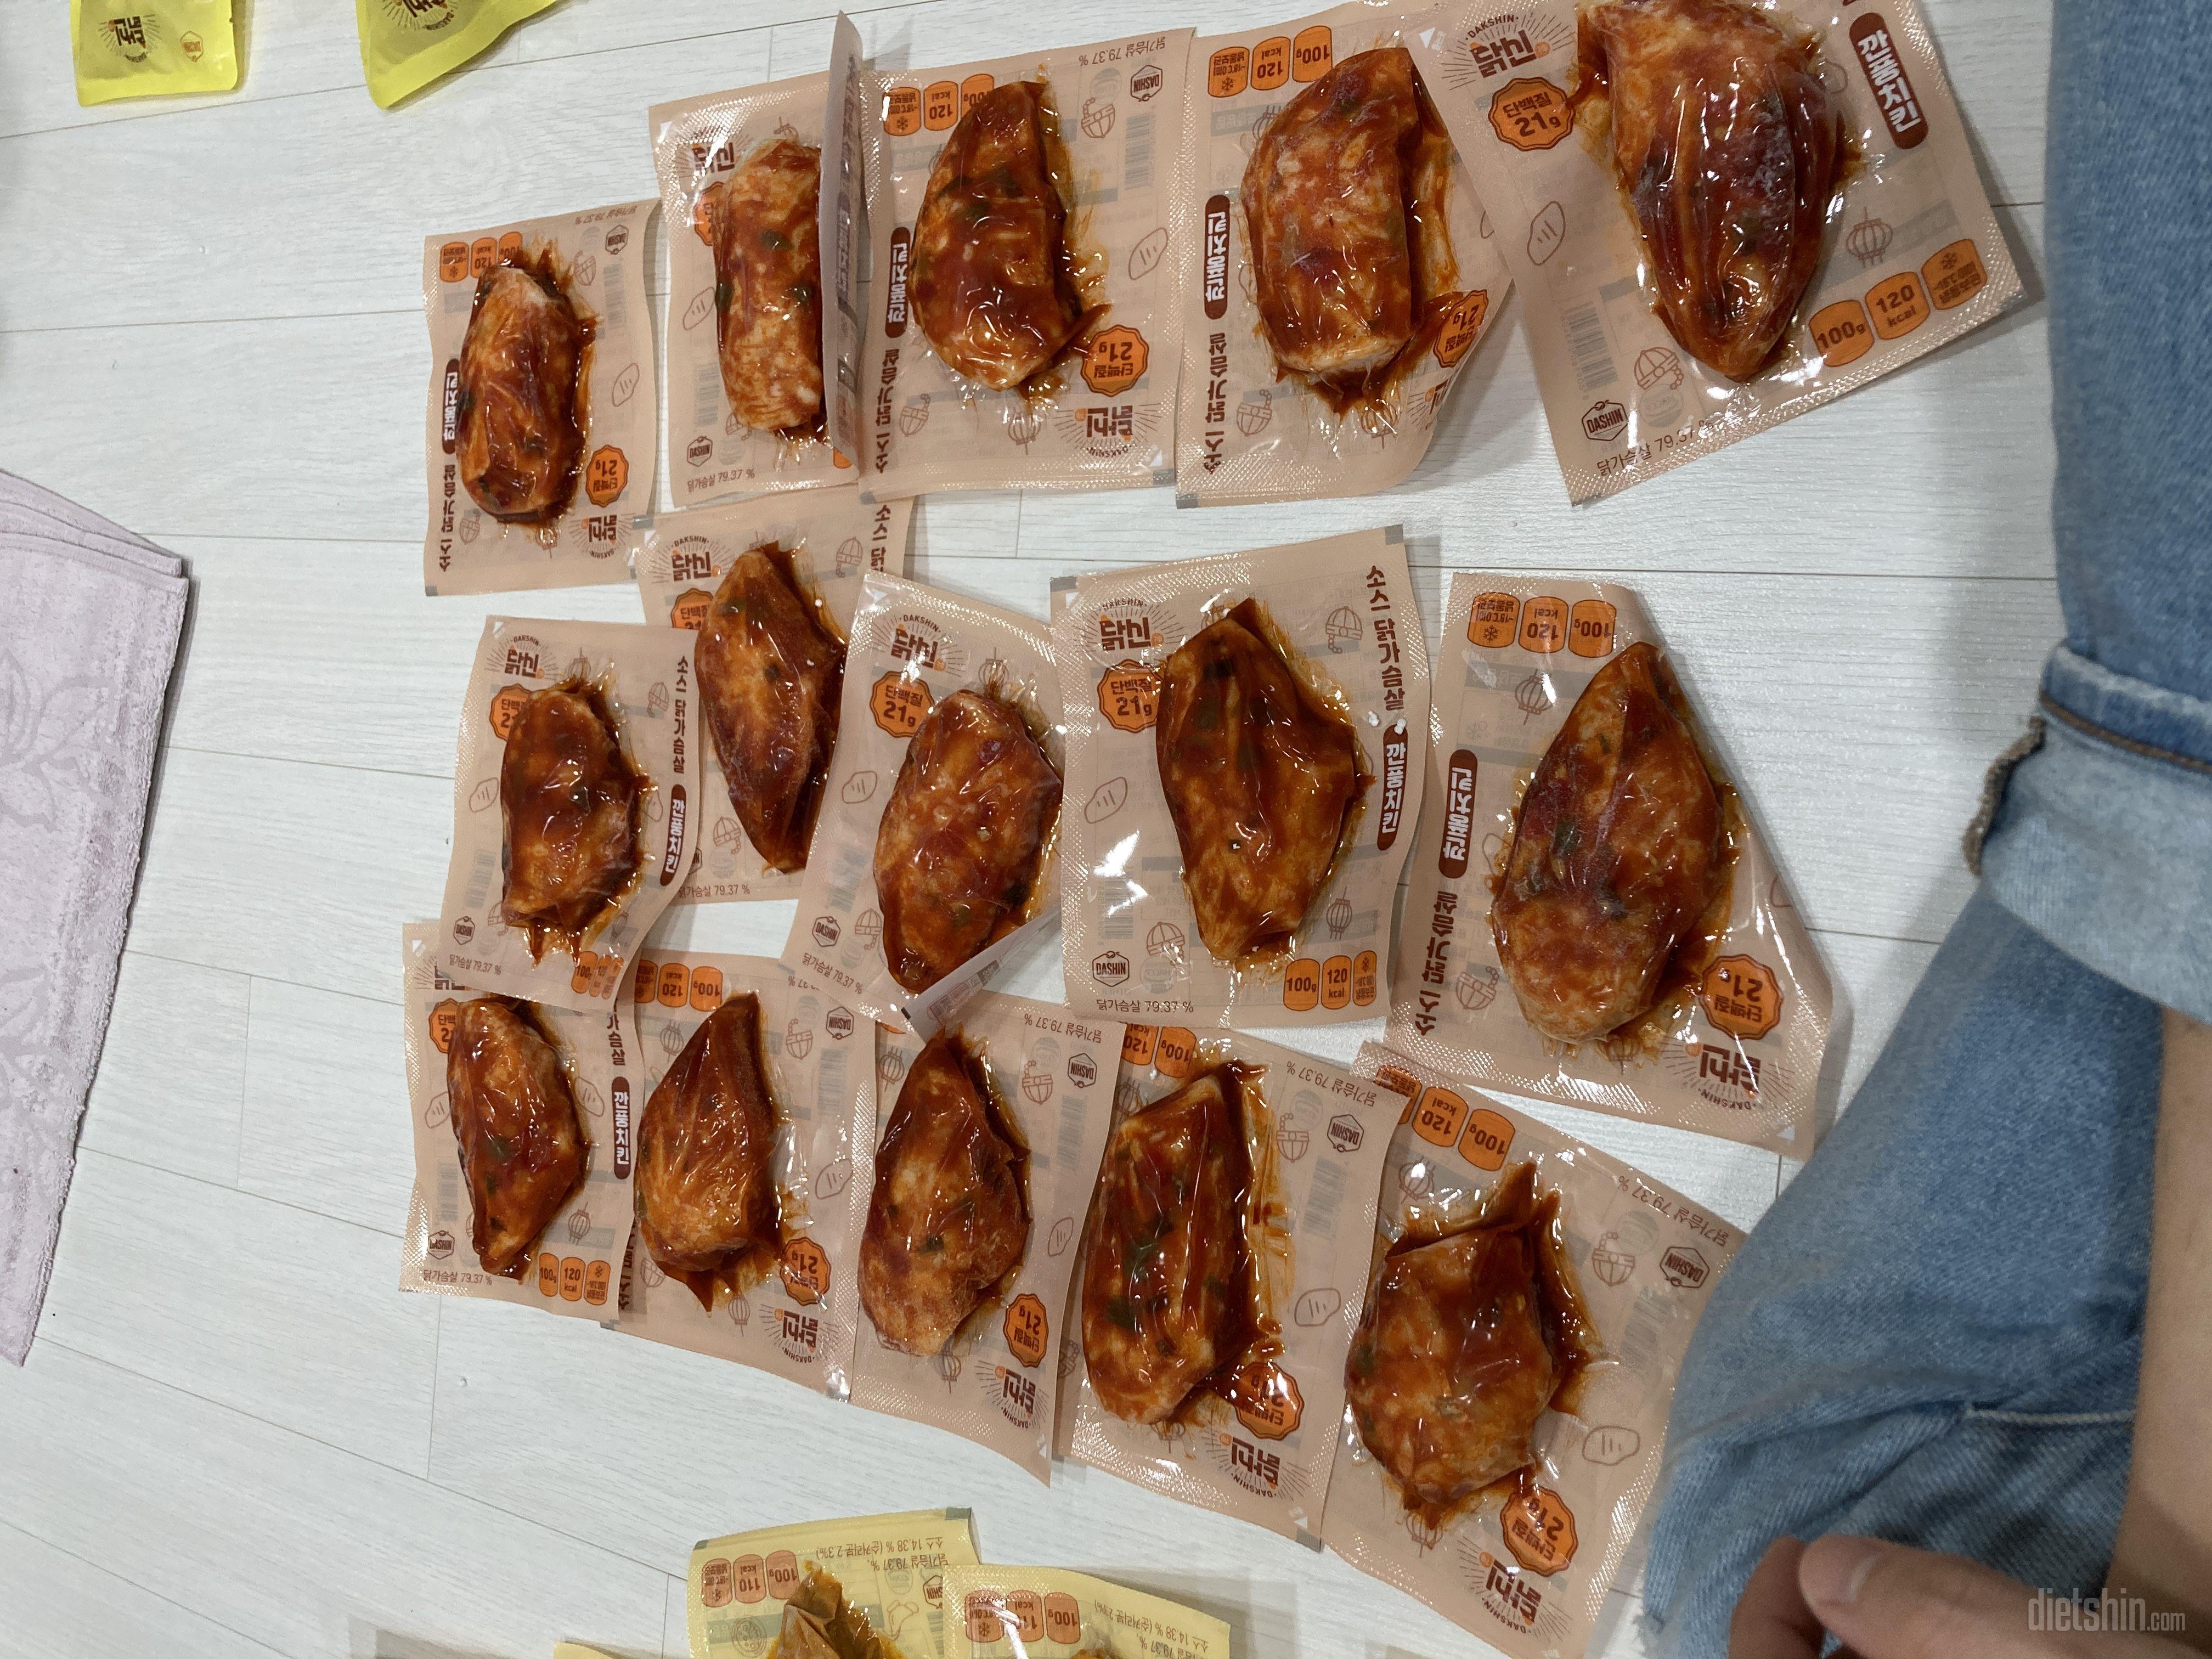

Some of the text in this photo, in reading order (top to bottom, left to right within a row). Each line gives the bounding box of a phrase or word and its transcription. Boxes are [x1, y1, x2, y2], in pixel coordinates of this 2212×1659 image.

[1468, 14, 1515, 38] DAKSHIN
[1079, 37, 1165, 66] 닭가슴살 79.37 %
[1261, 48, 1281, 60] kcal
[1296, 45, 1330, 64] 100g
[1470, 30, 1537, 78] 닭신
[1257, 61, 1283, 78] 120
[1133, 75, 1160, 92] DASHIN
[1858, 29, 1921, 133] 깐풍치킨
[931, 91, 951, 103] kcal
[963, 92, 986, 108] 00g
[1503, 91, 1552, 119] 단백질
[929, 104, 953, 120] 120
[1515, 112, 1561, 137] 21g
[475, 256, 492, 269] 120
[1205, 212, 1227, 302] 깐풍치킨
[889, 242, 907, 323] 깐풍치킨
[1877, 285, 1915, 313] 120
[1453, 305, 1480, 331] 21g
[1887, 305, 1916, 328] kcal
[1817, 321, 1864, 348] 100g
[1099, 342, 1132, 362] 21g
[1094, 363, 1133, 378] 단백질
[444, 371, 458, 441] 깐풍치킨
[876, 349, 900, 473] 소스 닭가슴살
[1204, 332, 1228, 475] 소스 닭가슴살
[1087, 406, 1132, 438] 닭신
[1587, 409, 1623, 433] DASHIN
[595, 460, 618, 476] 21g
[1597, 443, 1652, 476] 닭가슴살
[687, 469, 755, 493] 닭가슴살 79.37 %
[439, 465, 456, 572] 소스 닭가슴살
[588, 515, 617, 543] 닭신
[872, 504, 891, 541] 소스
[674, 535, 708, 547] DAKSHIN
[589, 549, 614, 559] DAKSHIN
[672, 551, 712, 581] 닭신
[903, 614, 939, 633] DAKSHIN
[1534, 608, 1559, 620] kcal
[1099, 617, 1151, 651] 닭신
[1366, 566, 1406, 712] 소스 닭가슴살
[1527, 623, 1559, 641] 120
[1574, 618, 1611, 639] 100g
[891, 628, 939, 668] 닭신
[504, 648, 539, 679] 닭신
[885, 685, 923, 707] 단백질
[1110, 678, 1152, 695] 단백질
[673, 655, 688, 774] 소스 닭가슴살
[884, 701, 916, 727] 21g
[1117, 695, 1152, 716] 21g
[1383, 742, 1406, 834] 깐풍치킨
[1443, 766, 1472, 861] 깐풍치킨
[665, 798, 685, 873] 깐풍치킨
[714, 884, 738, 895] 79.37
[742, 884, 751, 895] %
[815, 922, 838, 941] DASHIN
[449, 953, 502, 975] 닭가슴살 79.37 %
[803, 952, 833, 977] 닭가슴살
[833, 969, 854, 988] 79.37
[855, 982, 864, 995] %
[1096, 962, 1126, 975] DASHIN
[1415, 891, 1457, 1036] 소스 닭가슴살
[665, 972, 682, 981] kcal
[1286, 977, 1317, 993] 100g
[1327, 968, 1348, 985] 120
[1720, 968, 1763, 1003] 21g
[662, 983, 684, 997] 120
[693, 980, 721, 997] 100g
[1328, 987, 1345, 999] kcal
[1096, 999, 1194, 1013] 닭가슴살 79.37 %
[1714, 994, 1763, 1023] 단백질
[828, 1017, 851, 1030] DASHIN
[1024, 1013, 1102, 1043] 닭가슴살 79.37 %
[606, 1012, 626, 1066] 가슴살
[1123, 1035, 1148, 1054] 120
[1161, 1040, 1190, 1063] 100g
[1070, 1062, 1094, 1080] DASHIN
[1286, 1061, 1296, 1075] %
[1298, 1067, 1329, 1089] 79.37
[1700, 1044, 1761, 1094] 닭신
[1331, 1077, 1378, 1108] 닭가슴살
[1702, 1089, 1751, 1111] DAKSHIN
[1431, 1097, 1457, 1117] kcal
[613, 1091, 630, 1165] 깐풍치킨
[1421, 1110, 1452, 1135] 120
[1330, 1122, 1360, 1146] DASHIN
[1469, 1124, 1506, 1155] 100g
[1618, 1175, 1729, 1247] 닭가슴살 79.37 %
[792, 1249, 818, 1274] 21g
[1664, 1253, 1704, 1283] DASHIN
[424, 1269, 493, 1285] 닭가슴살 79.37 %
[539, 1267, 557, 1283] 100g
[564, 1267, 580, 1282] 120
[782, 1311, 819, 1348] 닭신
[1019, 1306, 1041, 1336] 21g
[1013, 1327, 1040, 1353] 단백질
[784, 1347, 812, 1363] DAKSHIN
[1002, 1369, 1036, 1414] 닭신
[1002, 1408, 1029, 1429] DAKSHIN
[1232, 1437, 1280, 1486] 닭신
[1233, 1474, 1273, 1498] DAKSHIN
[885, 1541, 895, 1553] %
[897, 1539, 923, 1552] 14.38
[925, 1537, 944, 1550] 소스
[1511, 1517, 1556, 1562] 단백질
[740, 1565, 757, 1575] kcal
[883, 1558, 908, 1570] 79.37
[911, 1553, 949, 1570] 닭가슴살
[738, 1578, 761, 1593] 110
[769, 1568, 798, 1583] 100g
[926, 1587, 943, 1600] SHIN
[1486, 1559, 1542, 1624] 닭신
[1014, 1601, 1034, 1611] kcal
[1483, 1600, 1527, 1634] DAKSHIN
[1047, 1609, 1078, 1628] 100g
[1154, 1623, 1164, 1637] %
[1165, 1626, 1189, 1646] 14.38
[1149, 1640, 1173, 1658] 79.37
[1192, 1637, 1209, 1653] 소스
